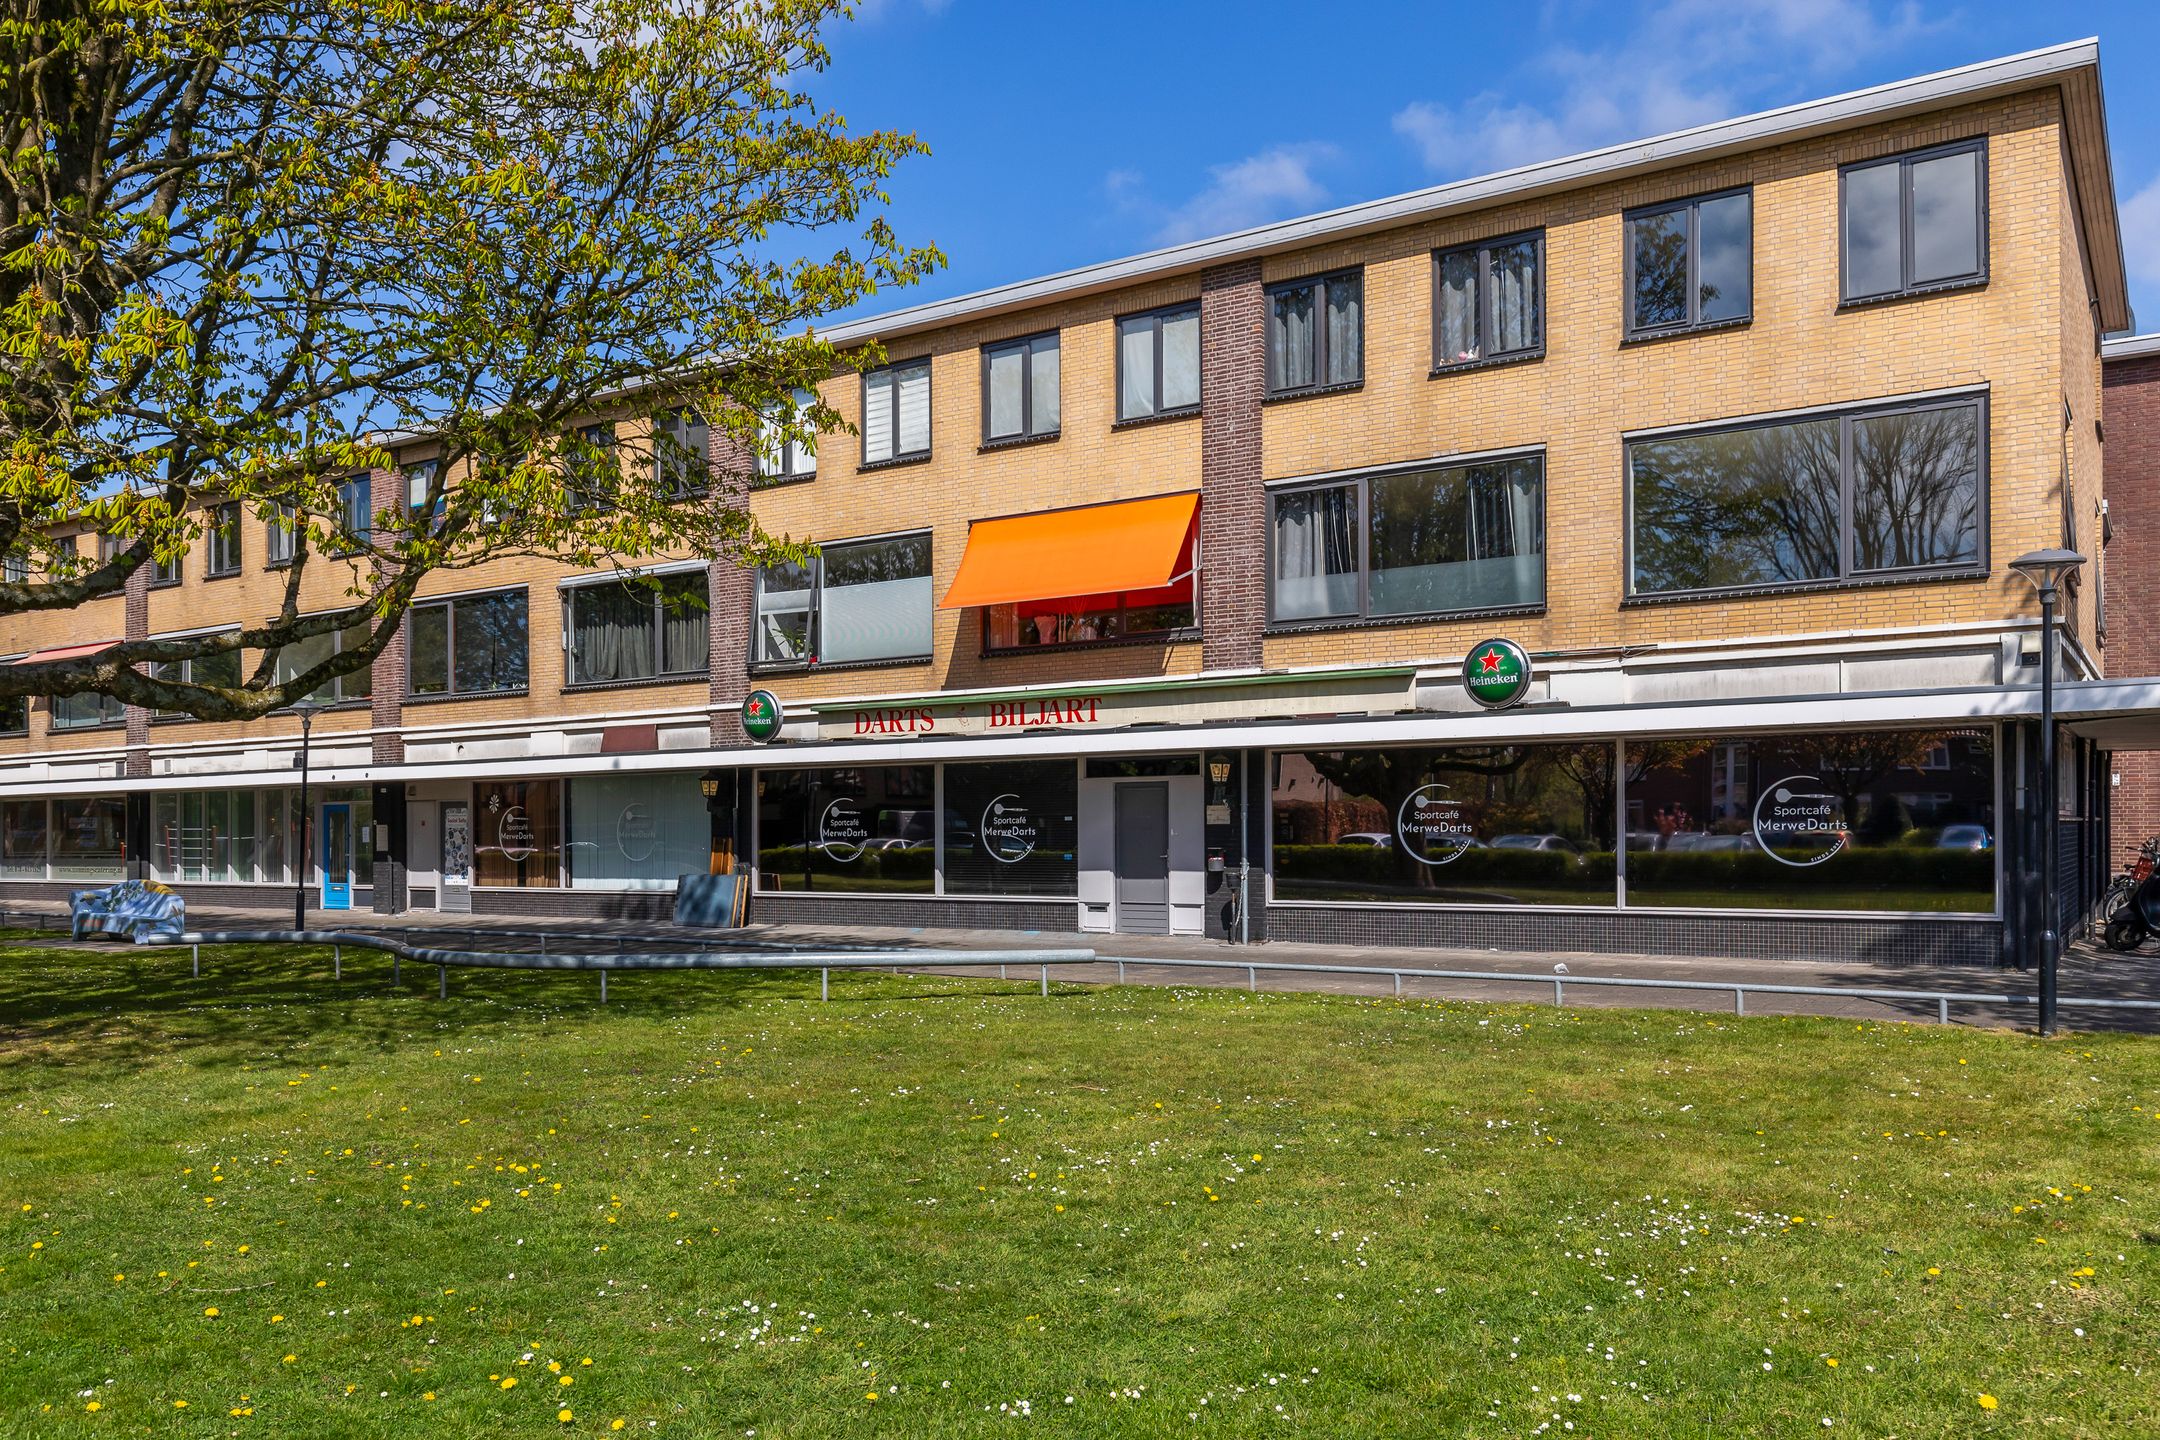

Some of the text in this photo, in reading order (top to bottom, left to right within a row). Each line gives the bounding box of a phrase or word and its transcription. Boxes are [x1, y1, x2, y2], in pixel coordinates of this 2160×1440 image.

[1470, 674, 1518, 687] Heineken
[853, 707, 935, 735] DARTS
[989, 697, 1102, 728] BILJART
[1414, 810, 1460, 820] Sportcafé
[1774, 805, 1831, 817] Sportcafé
[830, 819, 860, 827] Sportcafé
[993, 816, 1027, 825] Sportcafé
[1758, 818, 1848, 831] MerweDarts
[822, 827, 868, 837] MerweDarts
[984, 826, 1036, 836] MerweDarts
[1401, 821, 1472, 833] MerweDarts
